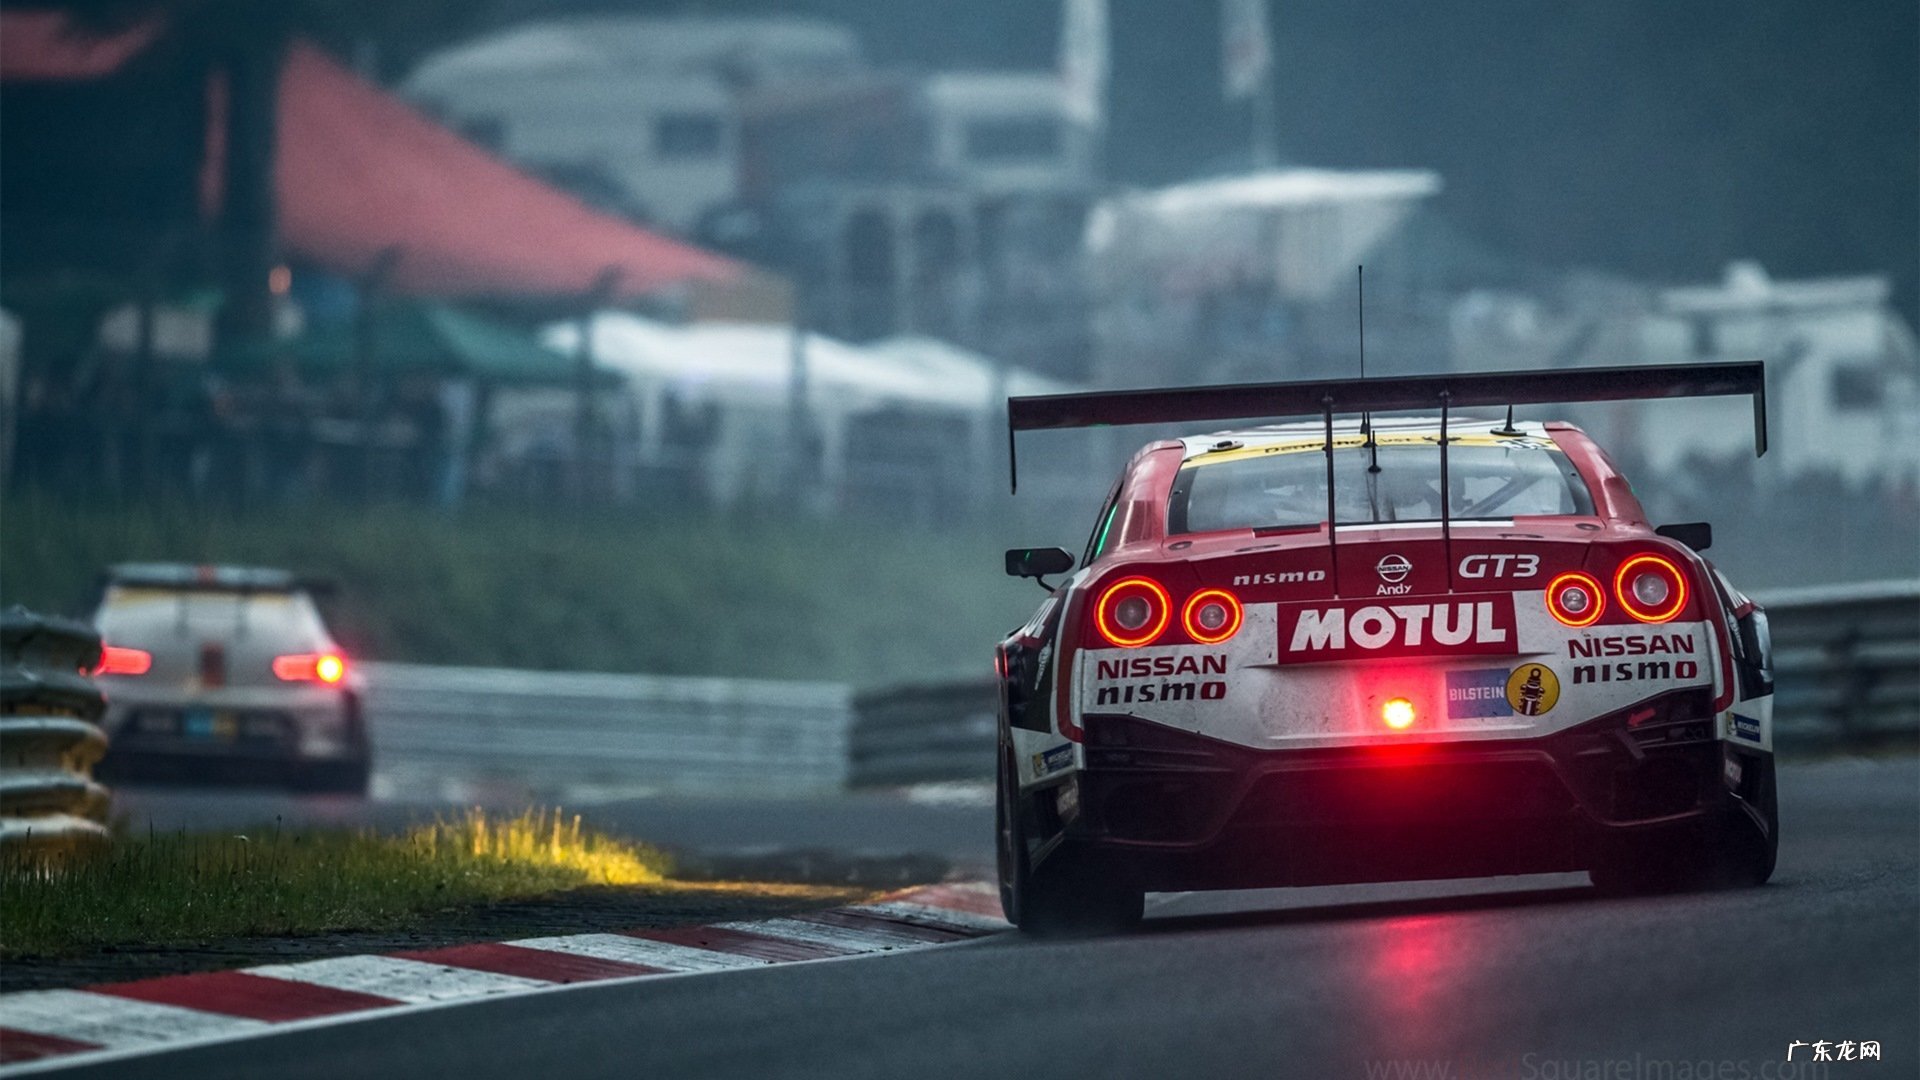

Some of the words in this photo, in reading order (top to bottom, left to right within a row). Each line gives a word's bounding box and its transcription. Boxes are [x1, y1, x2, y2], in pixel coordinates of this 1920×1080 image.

[1233, 570, 1326, 586] nismo
[1458, 554, 1540, 579] GT3
[1376, 583, 1412, 596] Andy
[1289, 601, 1507, 651] MOTUL
[1568, 634, 1695, 659] NISSAN
[1097, 655, 1227, 680] NISSAN
[1573, 660, 1697, 684] nismo
[1097, 682, 1227, 705] nismo
[1449, 686, 1505, 701] BILSTEIN
